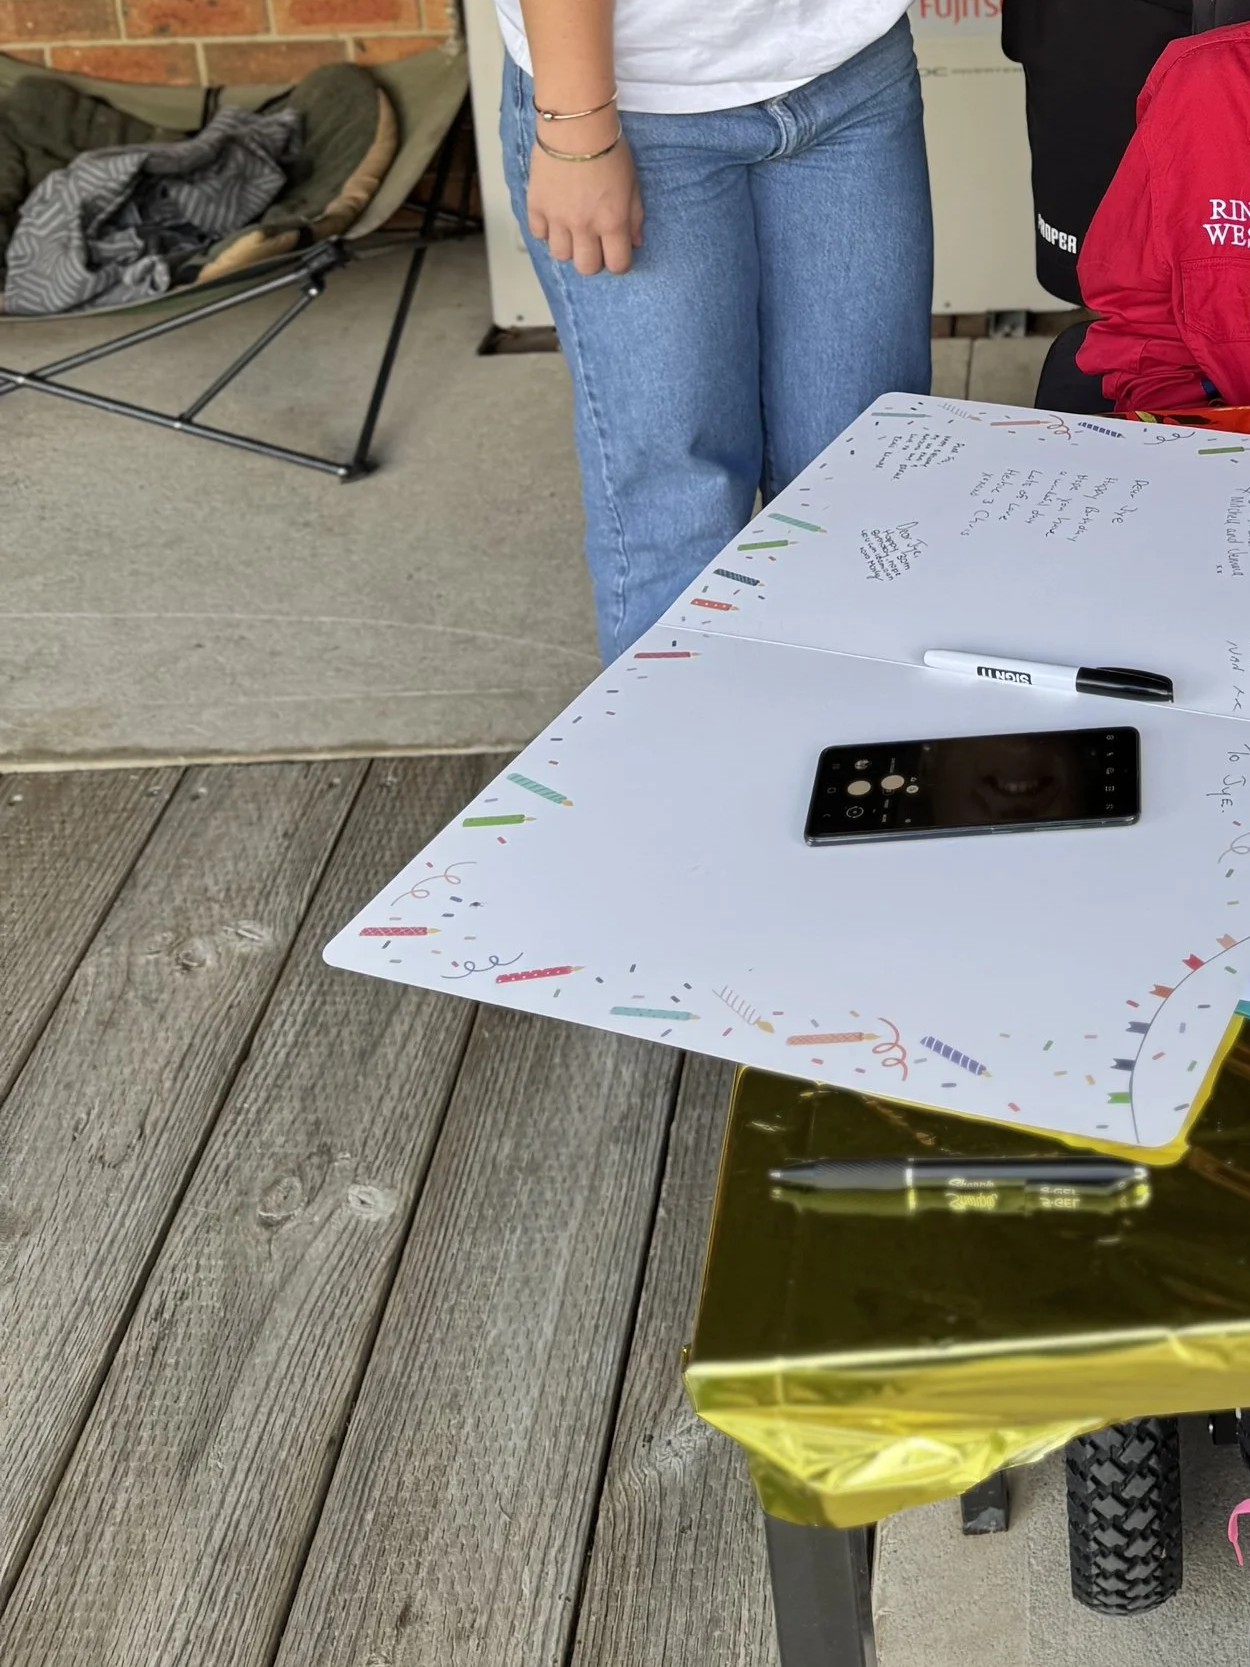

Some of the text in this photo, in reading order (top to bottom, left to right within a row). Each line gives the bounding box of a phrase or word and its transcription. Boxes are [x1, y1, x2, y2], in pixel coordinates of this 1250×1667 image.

[1130, 480, 1150, 499] Dear
[1066, 477, 1119, 542] Happy Birthday
[1226, 528, 1243, 544] and
